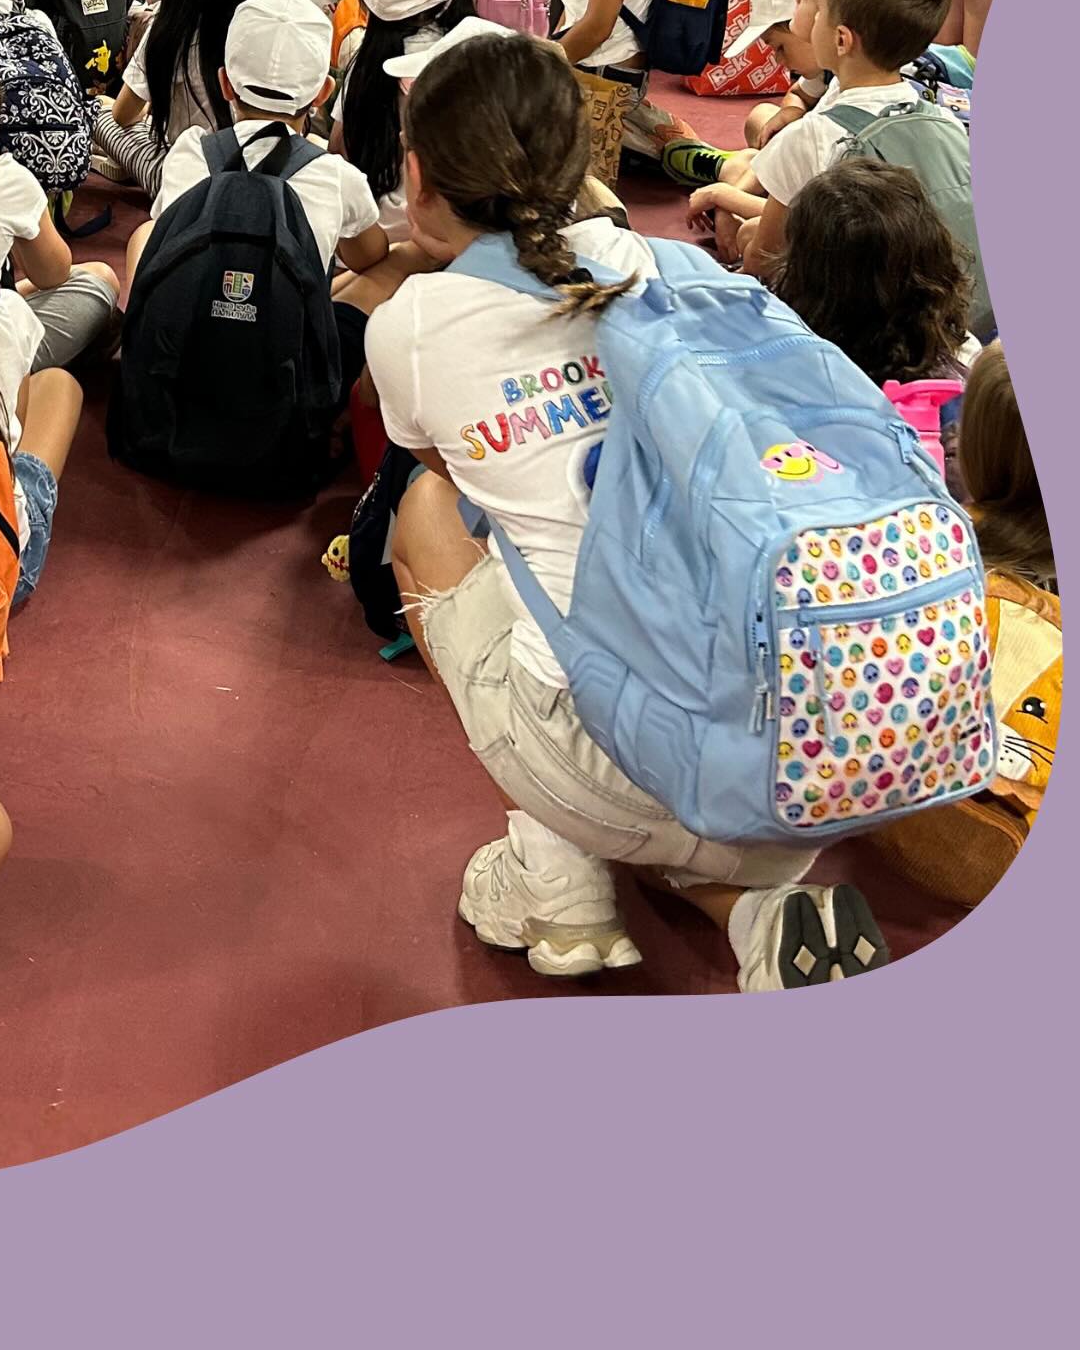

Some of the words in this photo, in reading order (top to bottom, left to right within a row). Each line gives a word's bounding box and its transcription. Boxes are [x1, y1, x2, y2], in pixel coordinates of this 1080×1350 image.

[708, 51, 752, 90] Bsk
[501, 355, 606, 407] BROOK
[460, 381, 614, 460] SUMME
